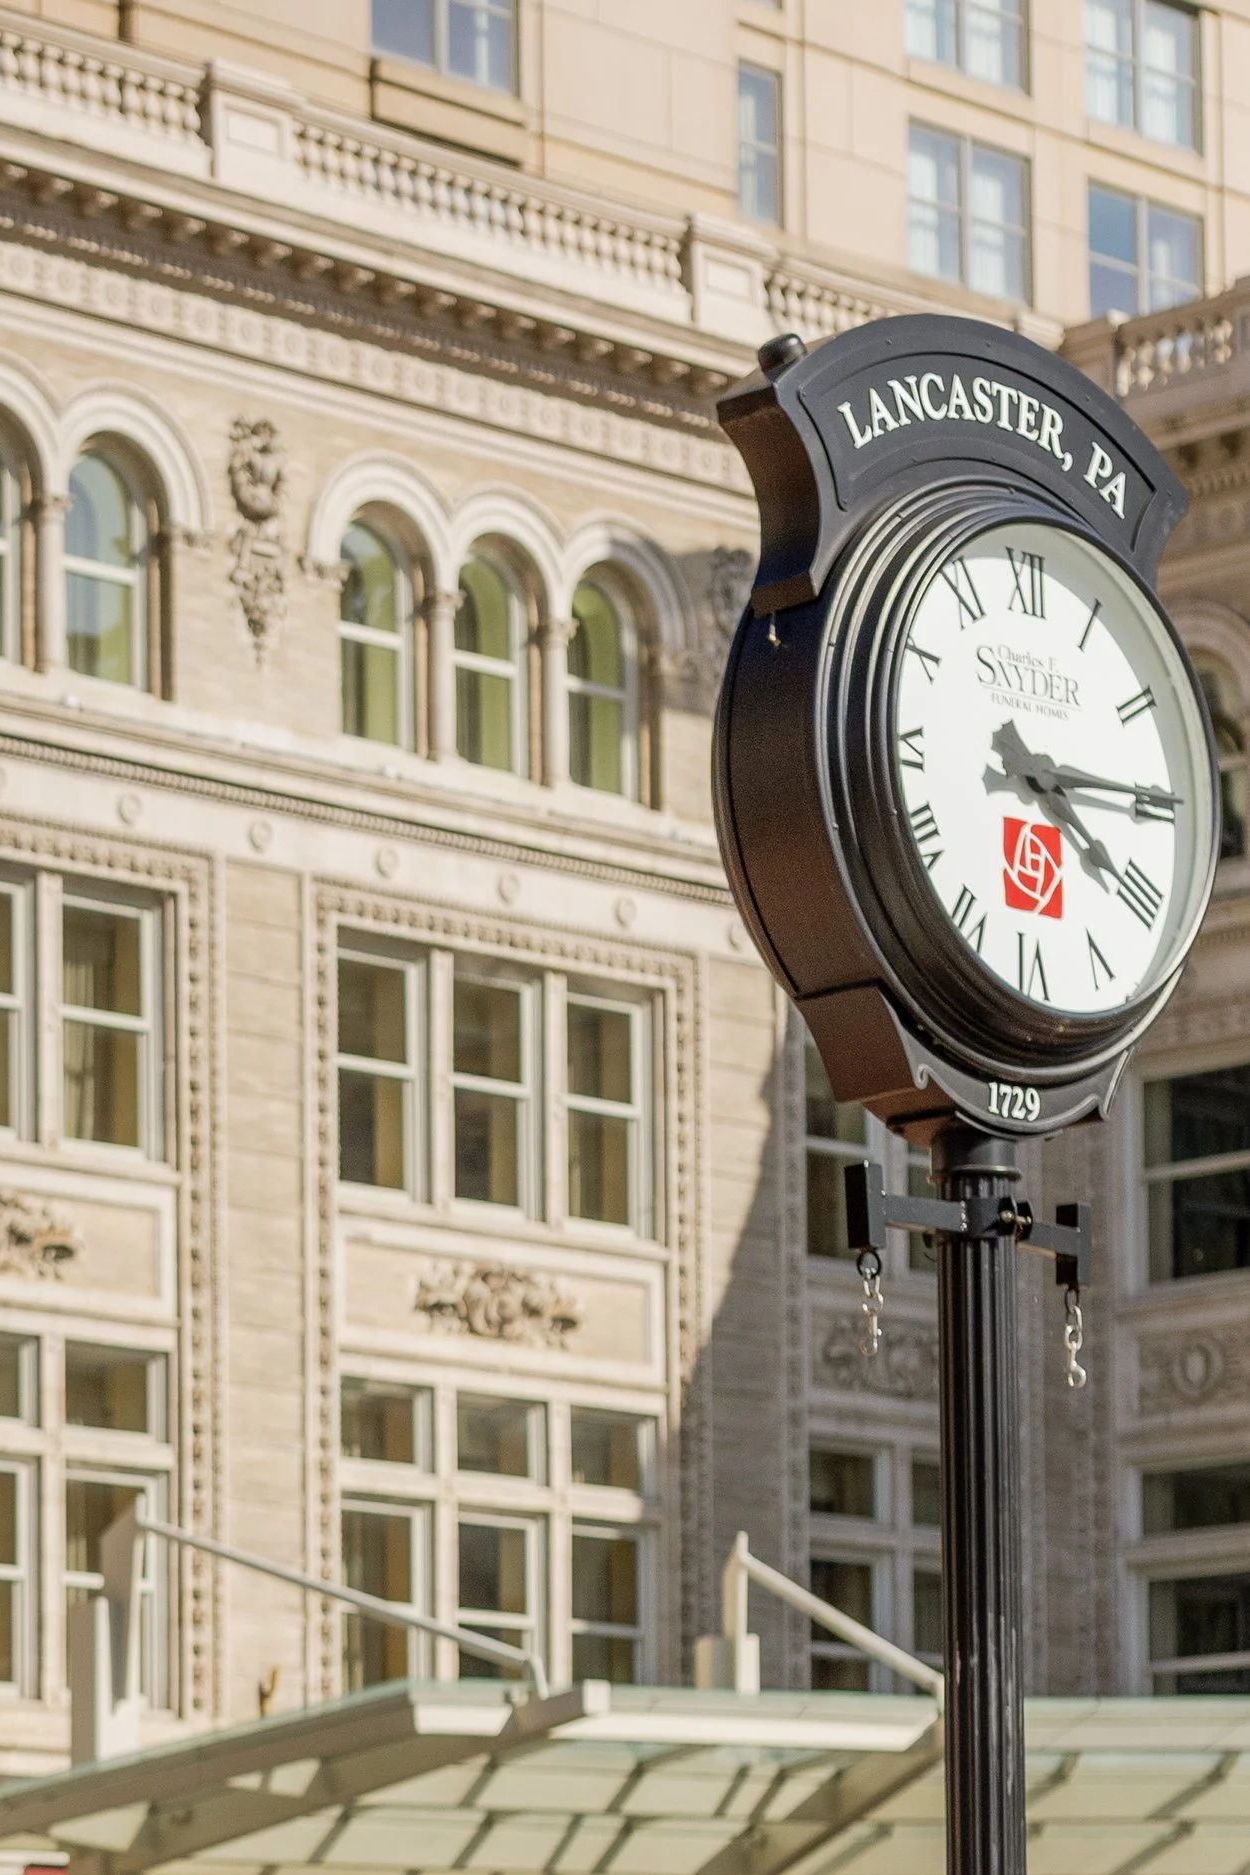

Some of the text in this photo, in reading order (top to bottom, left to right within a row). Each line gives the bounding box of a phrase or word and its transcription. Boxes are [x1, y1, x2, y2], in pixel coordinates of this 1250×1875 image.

[838, 372, 1126, 519] LANCASTER, PA
[938, 556, 986, 631] XI
[1006, 547, 1046, 619] XII
[997, 644, 1044, 667] Charles
[1077, 599, 1102, 651] I
[976, 645, 1081, 707] SNYDER
[991, 692, 1069, 721] FUNERAL HOMES
[1116, 685, 1157, 727] II
[1017, 931, 1050, 1001] VI
[1086, 927, 1116, 991] V
[988, 1081, 1041, 1122] 1729
